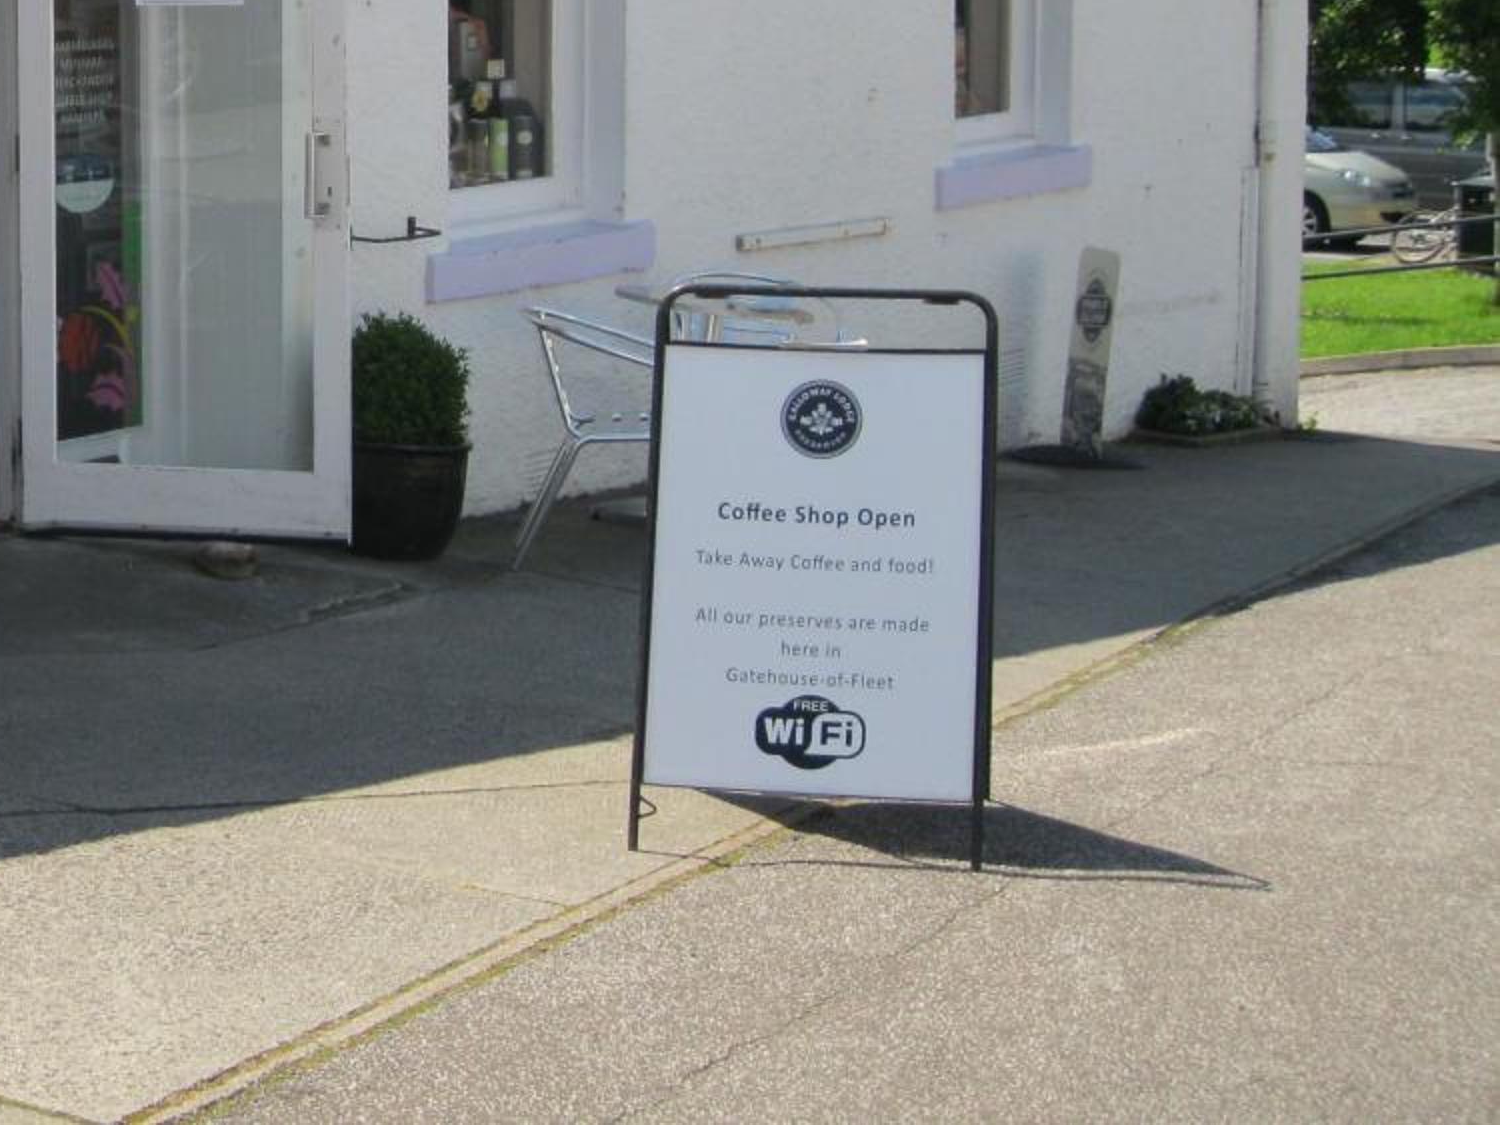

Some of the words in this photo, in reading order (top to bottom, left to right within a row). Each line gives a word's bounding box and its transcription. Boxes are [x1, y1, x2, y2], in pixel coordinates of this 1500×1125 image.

[717, 502, 787, 523] Coffee
[795, 506, 849, 529] Shop
[857, 508, 915, 531] Open
[696, 549, 733, 566] Take
[739, 552, 785, 572] Away
[790, 554, 845, 572] Coffee
[851, 555, 882, 572] and
[888, 557, 934, 575] food!
[695, 607, 717, 623] All
[723, 611, 752, 625] our
[758, 614, 843, 630] preserves
[848, 618, 876, 630] are
[881, 617, 929, 633] made
[780, 640, 819, 658] here
[825, 641, 841, 659] in
[725, 666, 896, 690] Gatehouse-of-Fleet
[792, 697, 829, 714] FREE
